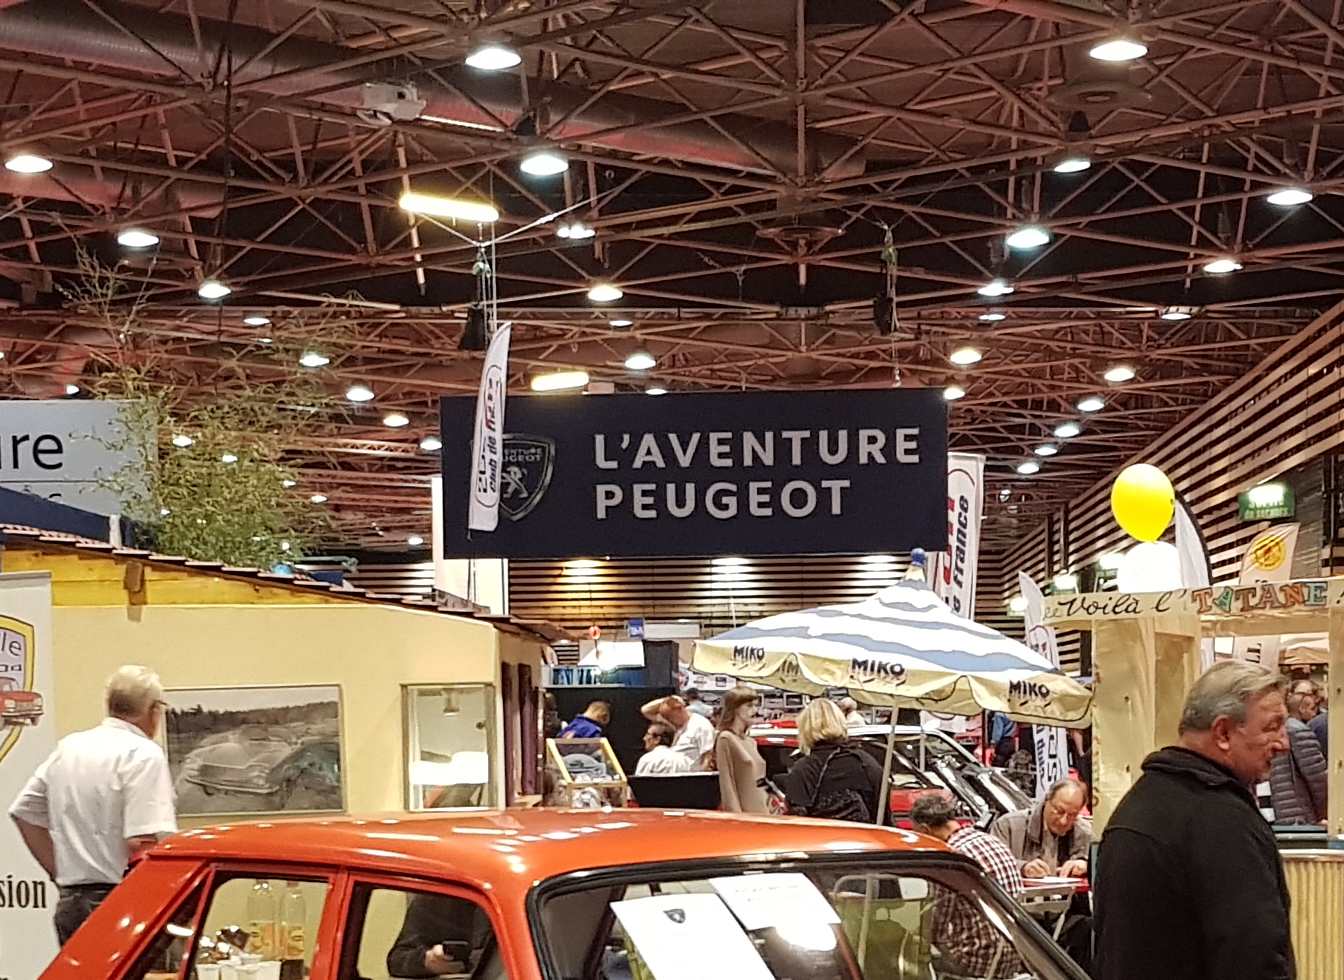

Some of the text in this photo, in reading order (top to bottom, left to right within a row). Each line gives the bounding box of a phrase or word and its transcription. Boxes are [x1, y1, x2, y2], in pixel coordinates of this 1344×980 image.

[594, 427, 921, 470] L'AVENTURE
[595, 479, 851, 520] PEUGEOT
[1058, 592, 1141, 616] Voilà
[733, 645, 765, 662] MIKO
[851, 657, 906, 677] MIKO
[1008, 679, 1051, 698] MIKO
